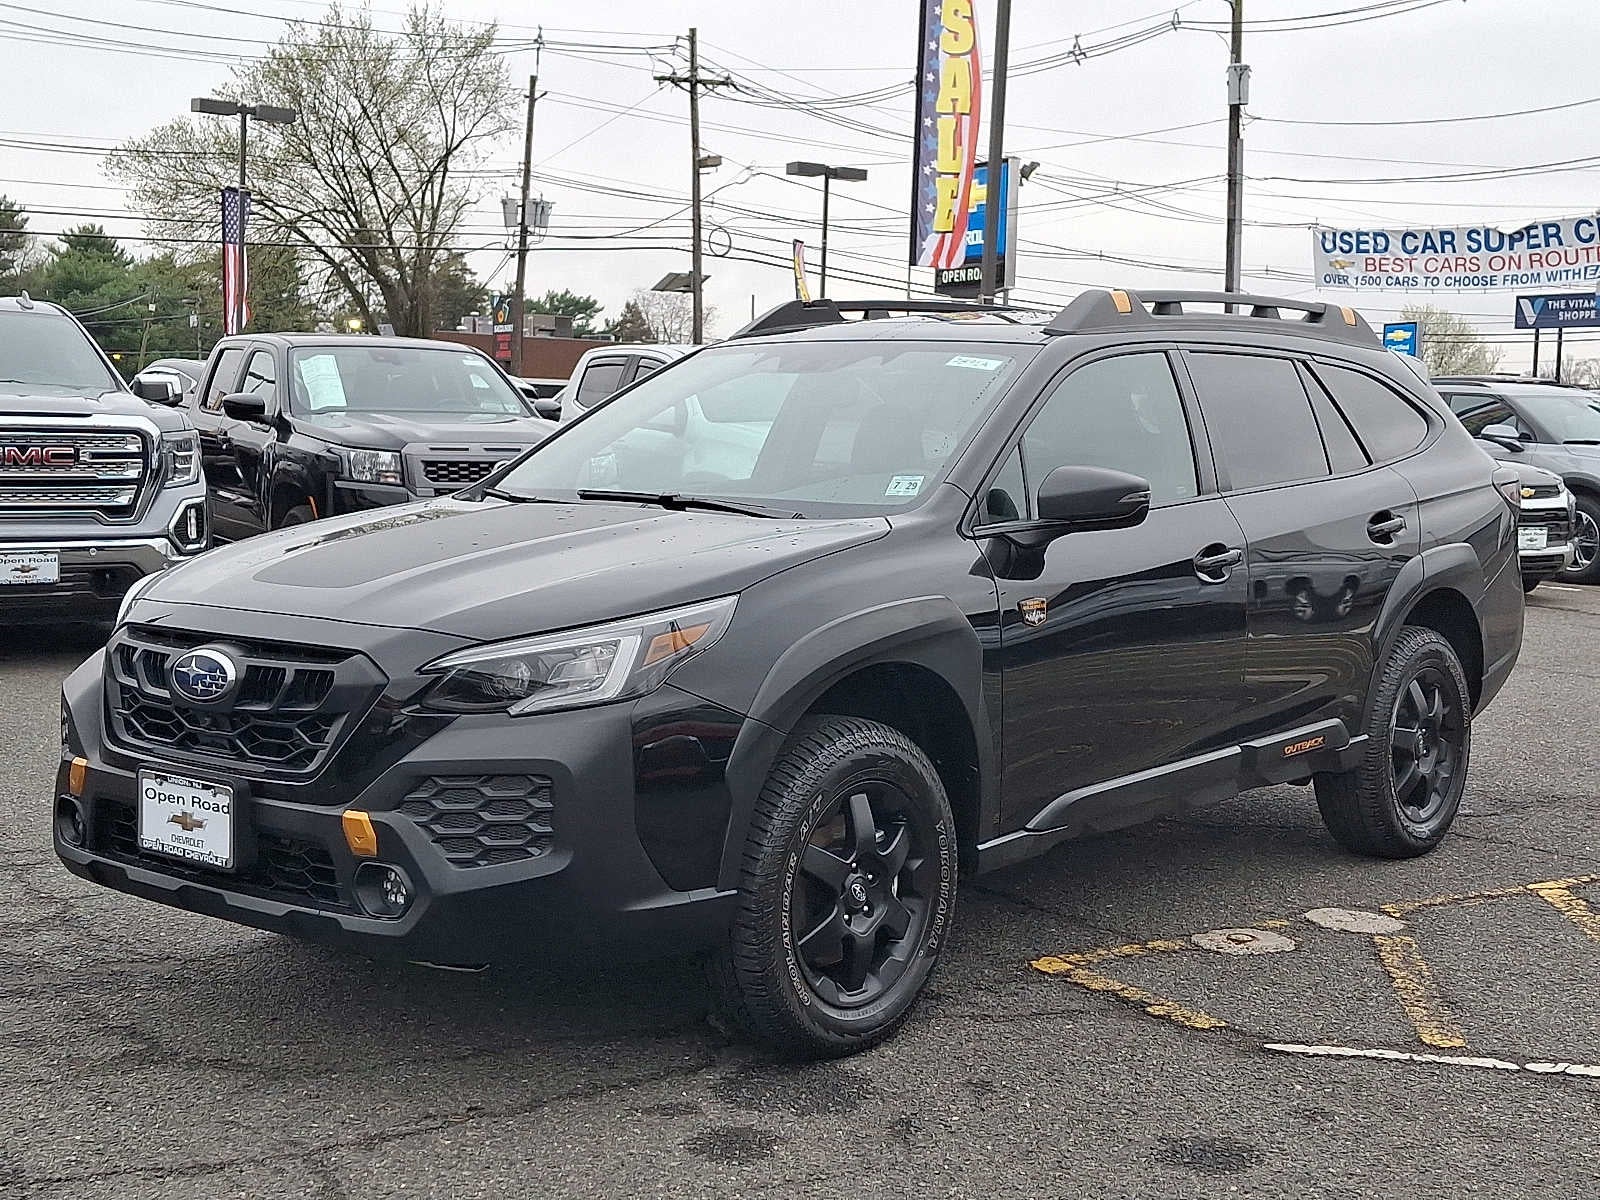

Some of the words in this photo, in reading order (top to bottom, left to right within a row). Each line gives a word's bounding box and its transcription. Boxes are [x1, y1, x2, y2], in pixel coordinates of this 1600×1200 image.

[933, 0, 975, 233] SALE
[1320, 231, 1390, 254] USED
[1401, 231, 1457, 255] CAR
[1466, 222, 1564, 253] SUPER
[1364, 257, 1418, 273] BEST
[1424, 255, 1481, 273] CARS
[1488, 254, 1521, 272] ON
[1529, 246, 1600, 269] ROUT
[942, 269, 966, 283] OPEN
[967, 268, 982, 281] RO
[1323, 273, 1349, 285] OVER
[1353, 275, 1382, 287] 1500
[1385, 275, 1419, 287] CARS
[1423, 276, 1440, 287] TO
[1444, 275, 1498, 287] CHOOSE
[1502, 271, 1541, 286] FROM
[1546, 267, 1581, 282] WITH
[1548, 299, 1567, 310] THE
[1558, 310, 1597, 321] SHOPPE
[0, 447, 74, 465] MC
[892, 481, 901, 490] 7
[905, 481, 918, 490] 29
[1284, 736, 1324, 755] OUTBACK
[144, 787, 186, 804] Open
[191, 795, 230, 815] Road
[170, 833, 205, 849] CHEVROLET
[142, 839, 162, 850] OPEN
[163, 844, 183, 856] ROAD
[184, 850, 228, 868] CHEVROLET
[928, 819, 951, 950] YOKOHAMA
